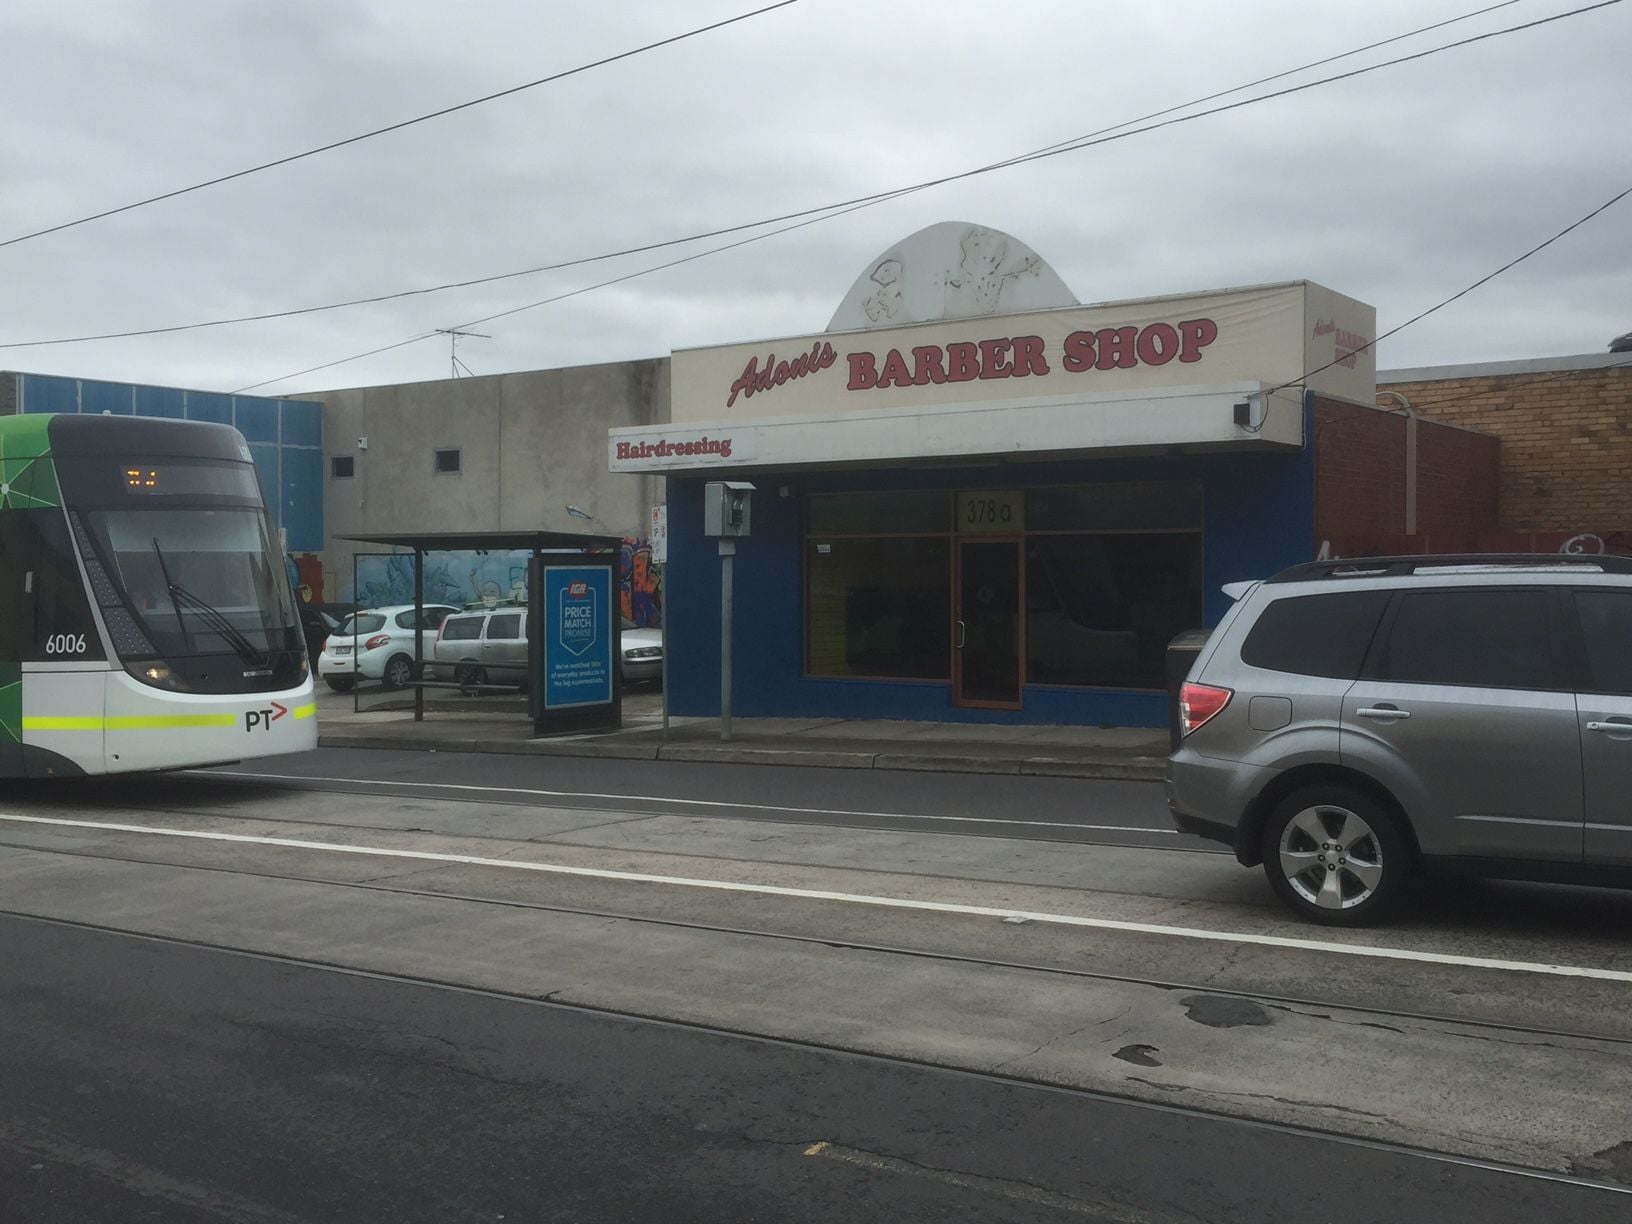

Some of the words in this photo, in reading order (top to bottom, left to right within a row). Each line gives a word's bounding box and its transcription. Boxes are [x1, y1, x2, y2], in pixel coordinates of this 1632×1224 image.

[727, 341, 838, 408] Adonis
[846, 335, 1050, 391] BARBER
[1062, 318, 1218, 373] SHOP
[616, 436, 732, 460] Hairdressing
[565, 606, 592, 618] PRICE
[564, 618, 592, 629] MATCH
[45, 633, 87, 654] 6006
